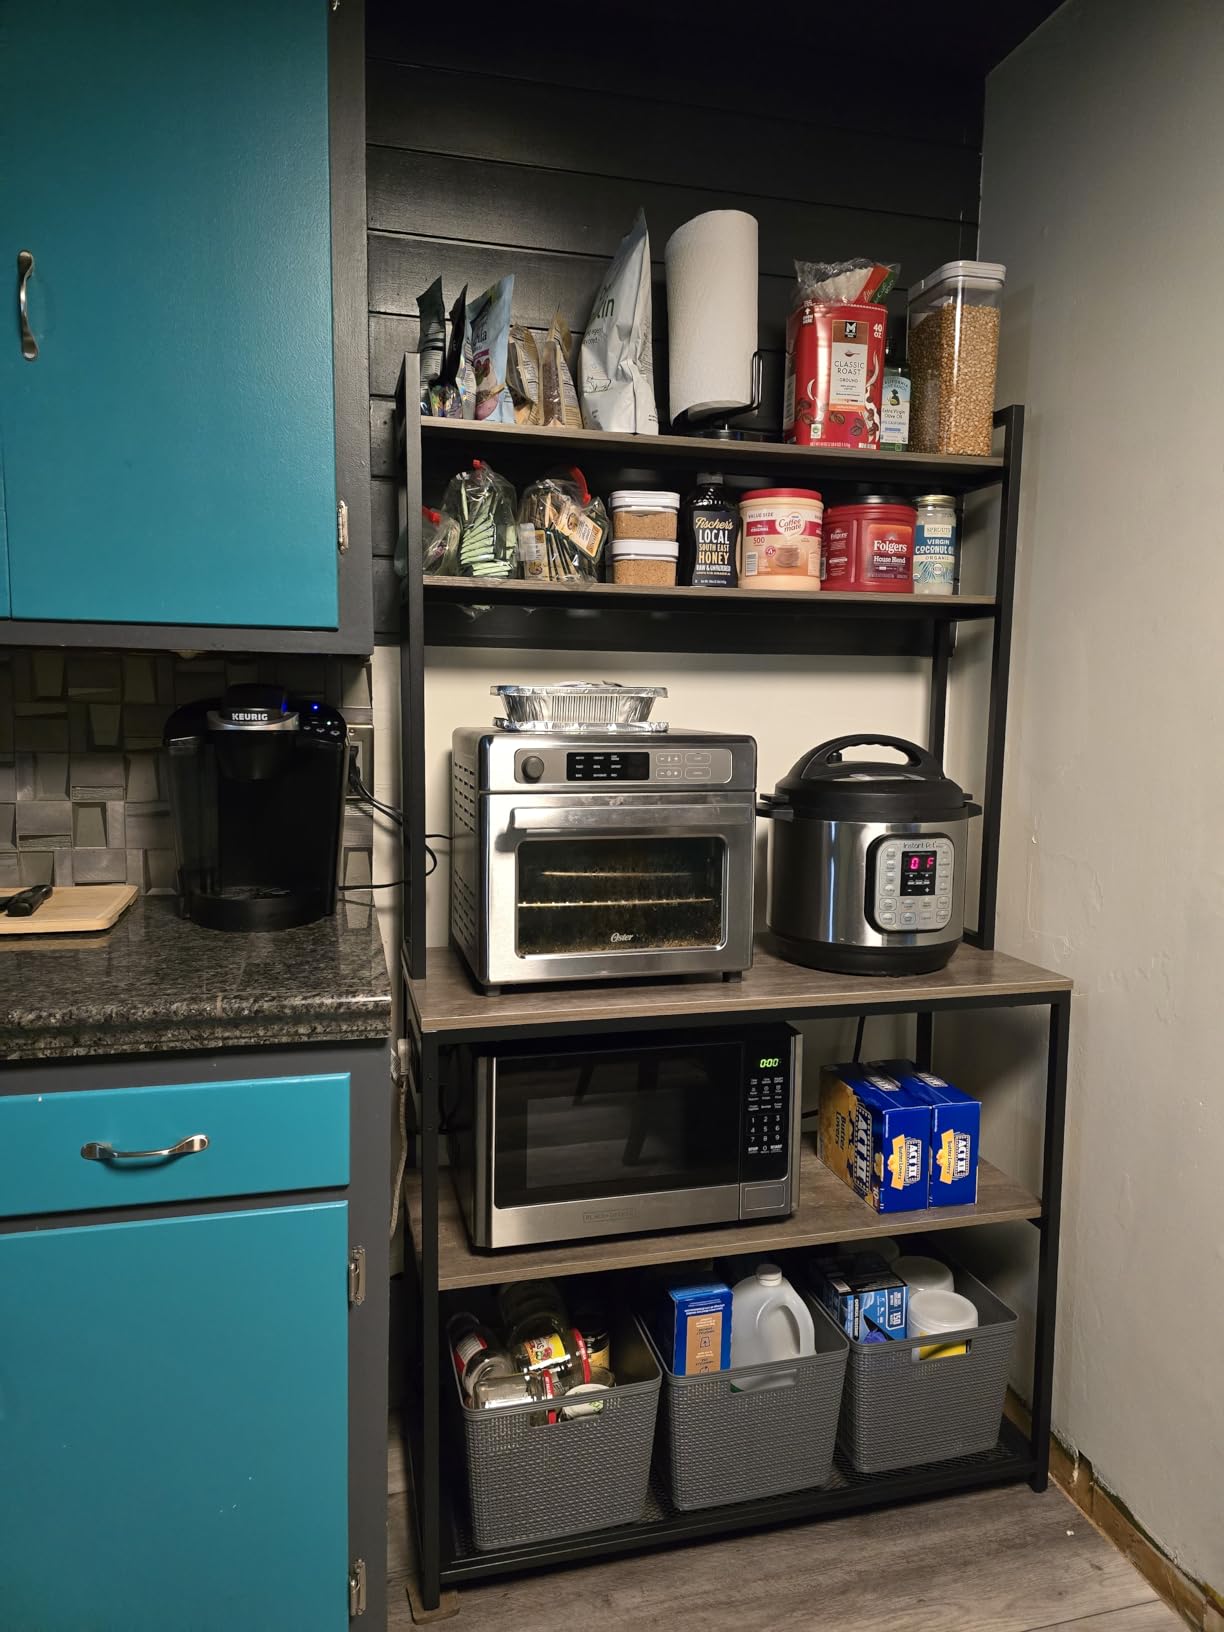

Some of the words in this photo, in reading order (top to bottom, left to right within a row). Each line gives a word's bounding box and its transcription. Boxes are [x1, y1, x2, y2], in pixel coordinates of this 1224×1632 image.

[845, 322, 857, 333] M
[873, 323, 883, 332] 40
[834, 360, 865, 369] CLASSIC
[837, 367, 861, 375] ROAST
[695, 516, 733, 530] Fischer's
[778, 518, 802, 528] Coffee
[784, 523, 802, 533] mate
[699, 529, 730, 544] LOCAL
[699, 543, 716, 552] SOUTH
[717, 544, 729, 552] EAST
[873, 540, 908, 554] Folgers
[915, 545, 948, 554] COCONUT
[699, 552, 729, 565] HONEY
[231, 713, 268, 721] KEURIG
[610, 932, 634, 943] Oster
[834, 1111, 842, 1145] Lovers
[839, 1115, 847, 1150] Butter
[856, 1115, 868, 1154] ACT
[908, 1144, 918, 1164] ACT
[957, 1139, 967, 1160] ACT
